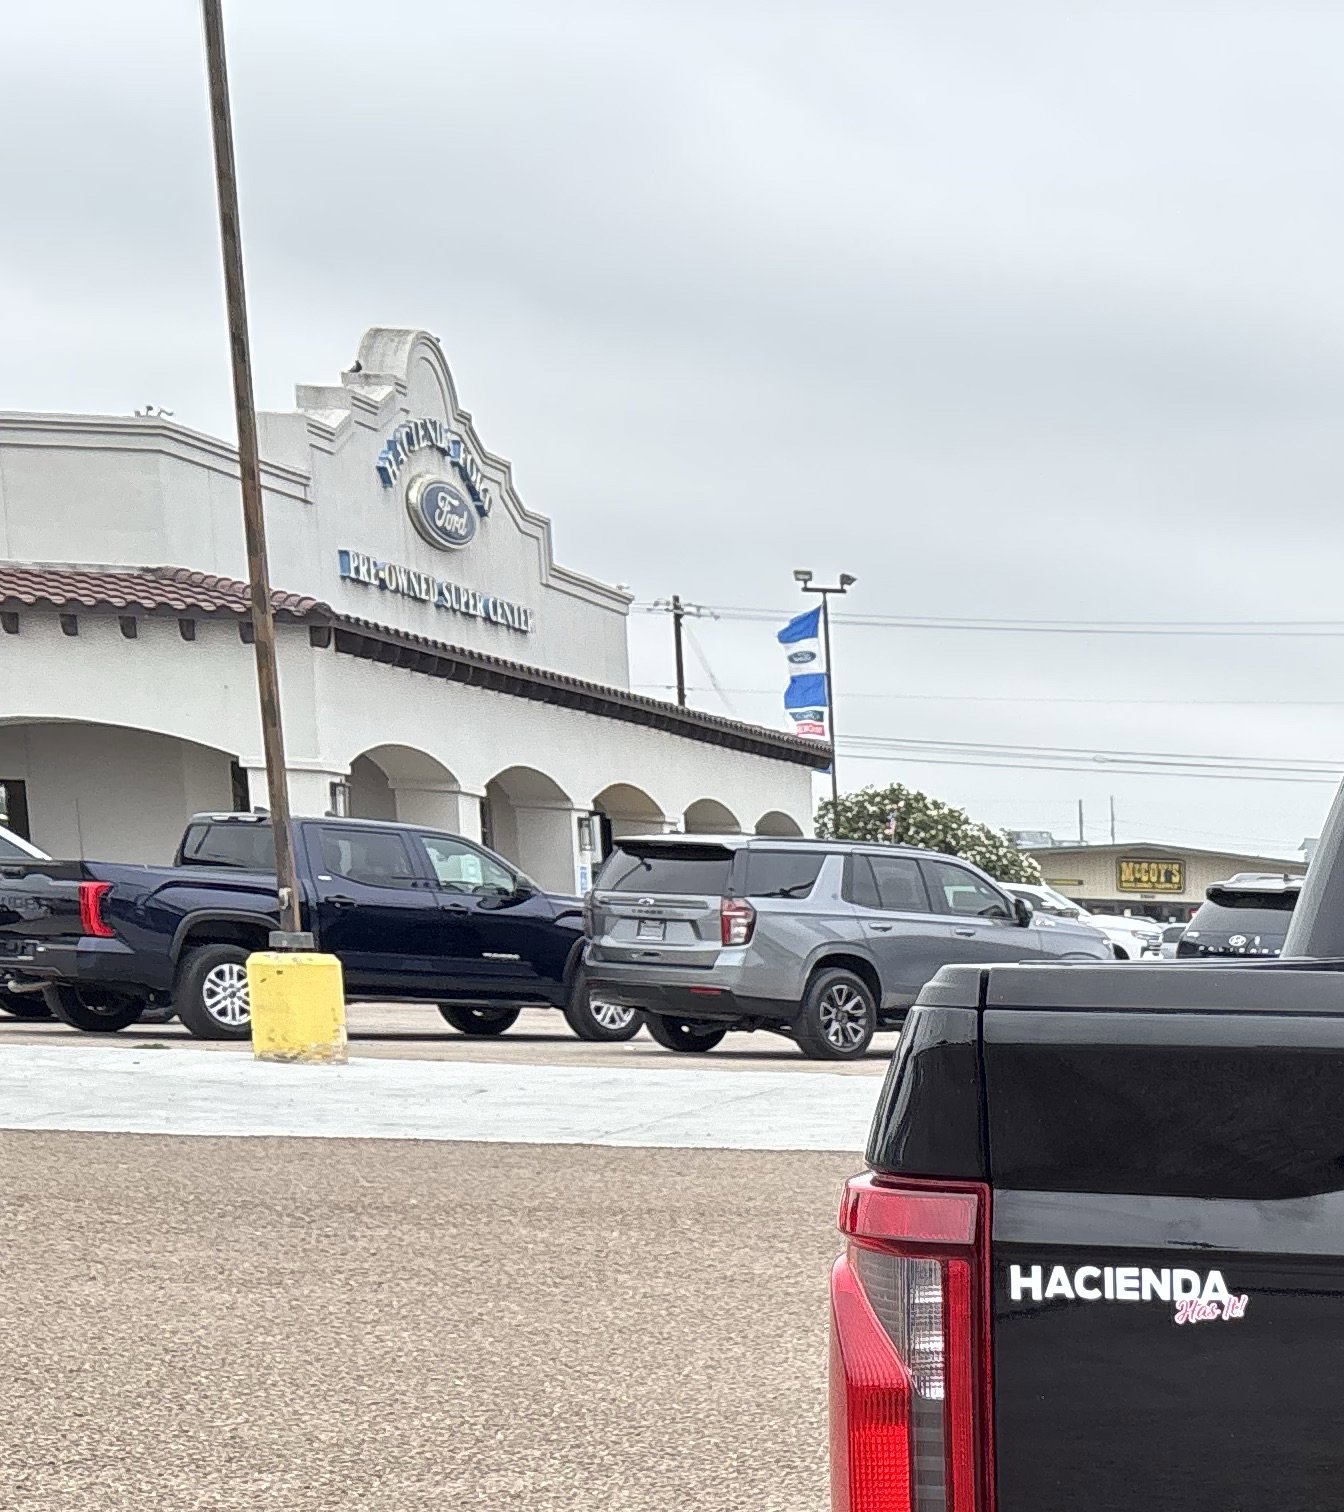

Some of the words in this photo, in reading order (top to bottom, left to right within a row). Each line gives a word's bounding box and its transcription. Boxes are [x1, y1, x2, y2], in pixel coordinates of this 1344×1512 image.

[434, 491, 468, 537] Ford
[345, 550, 439, 603] PRE-OWNED
[441, 581, 485, 616] SUPER
[488, 598, 535, 632] CENTER
[1009, 1264, 1229, 1301] HACIENDA
[1174, 1297, 1220, 1325] Has
[1219, 1294, 1248, 1319] It!
